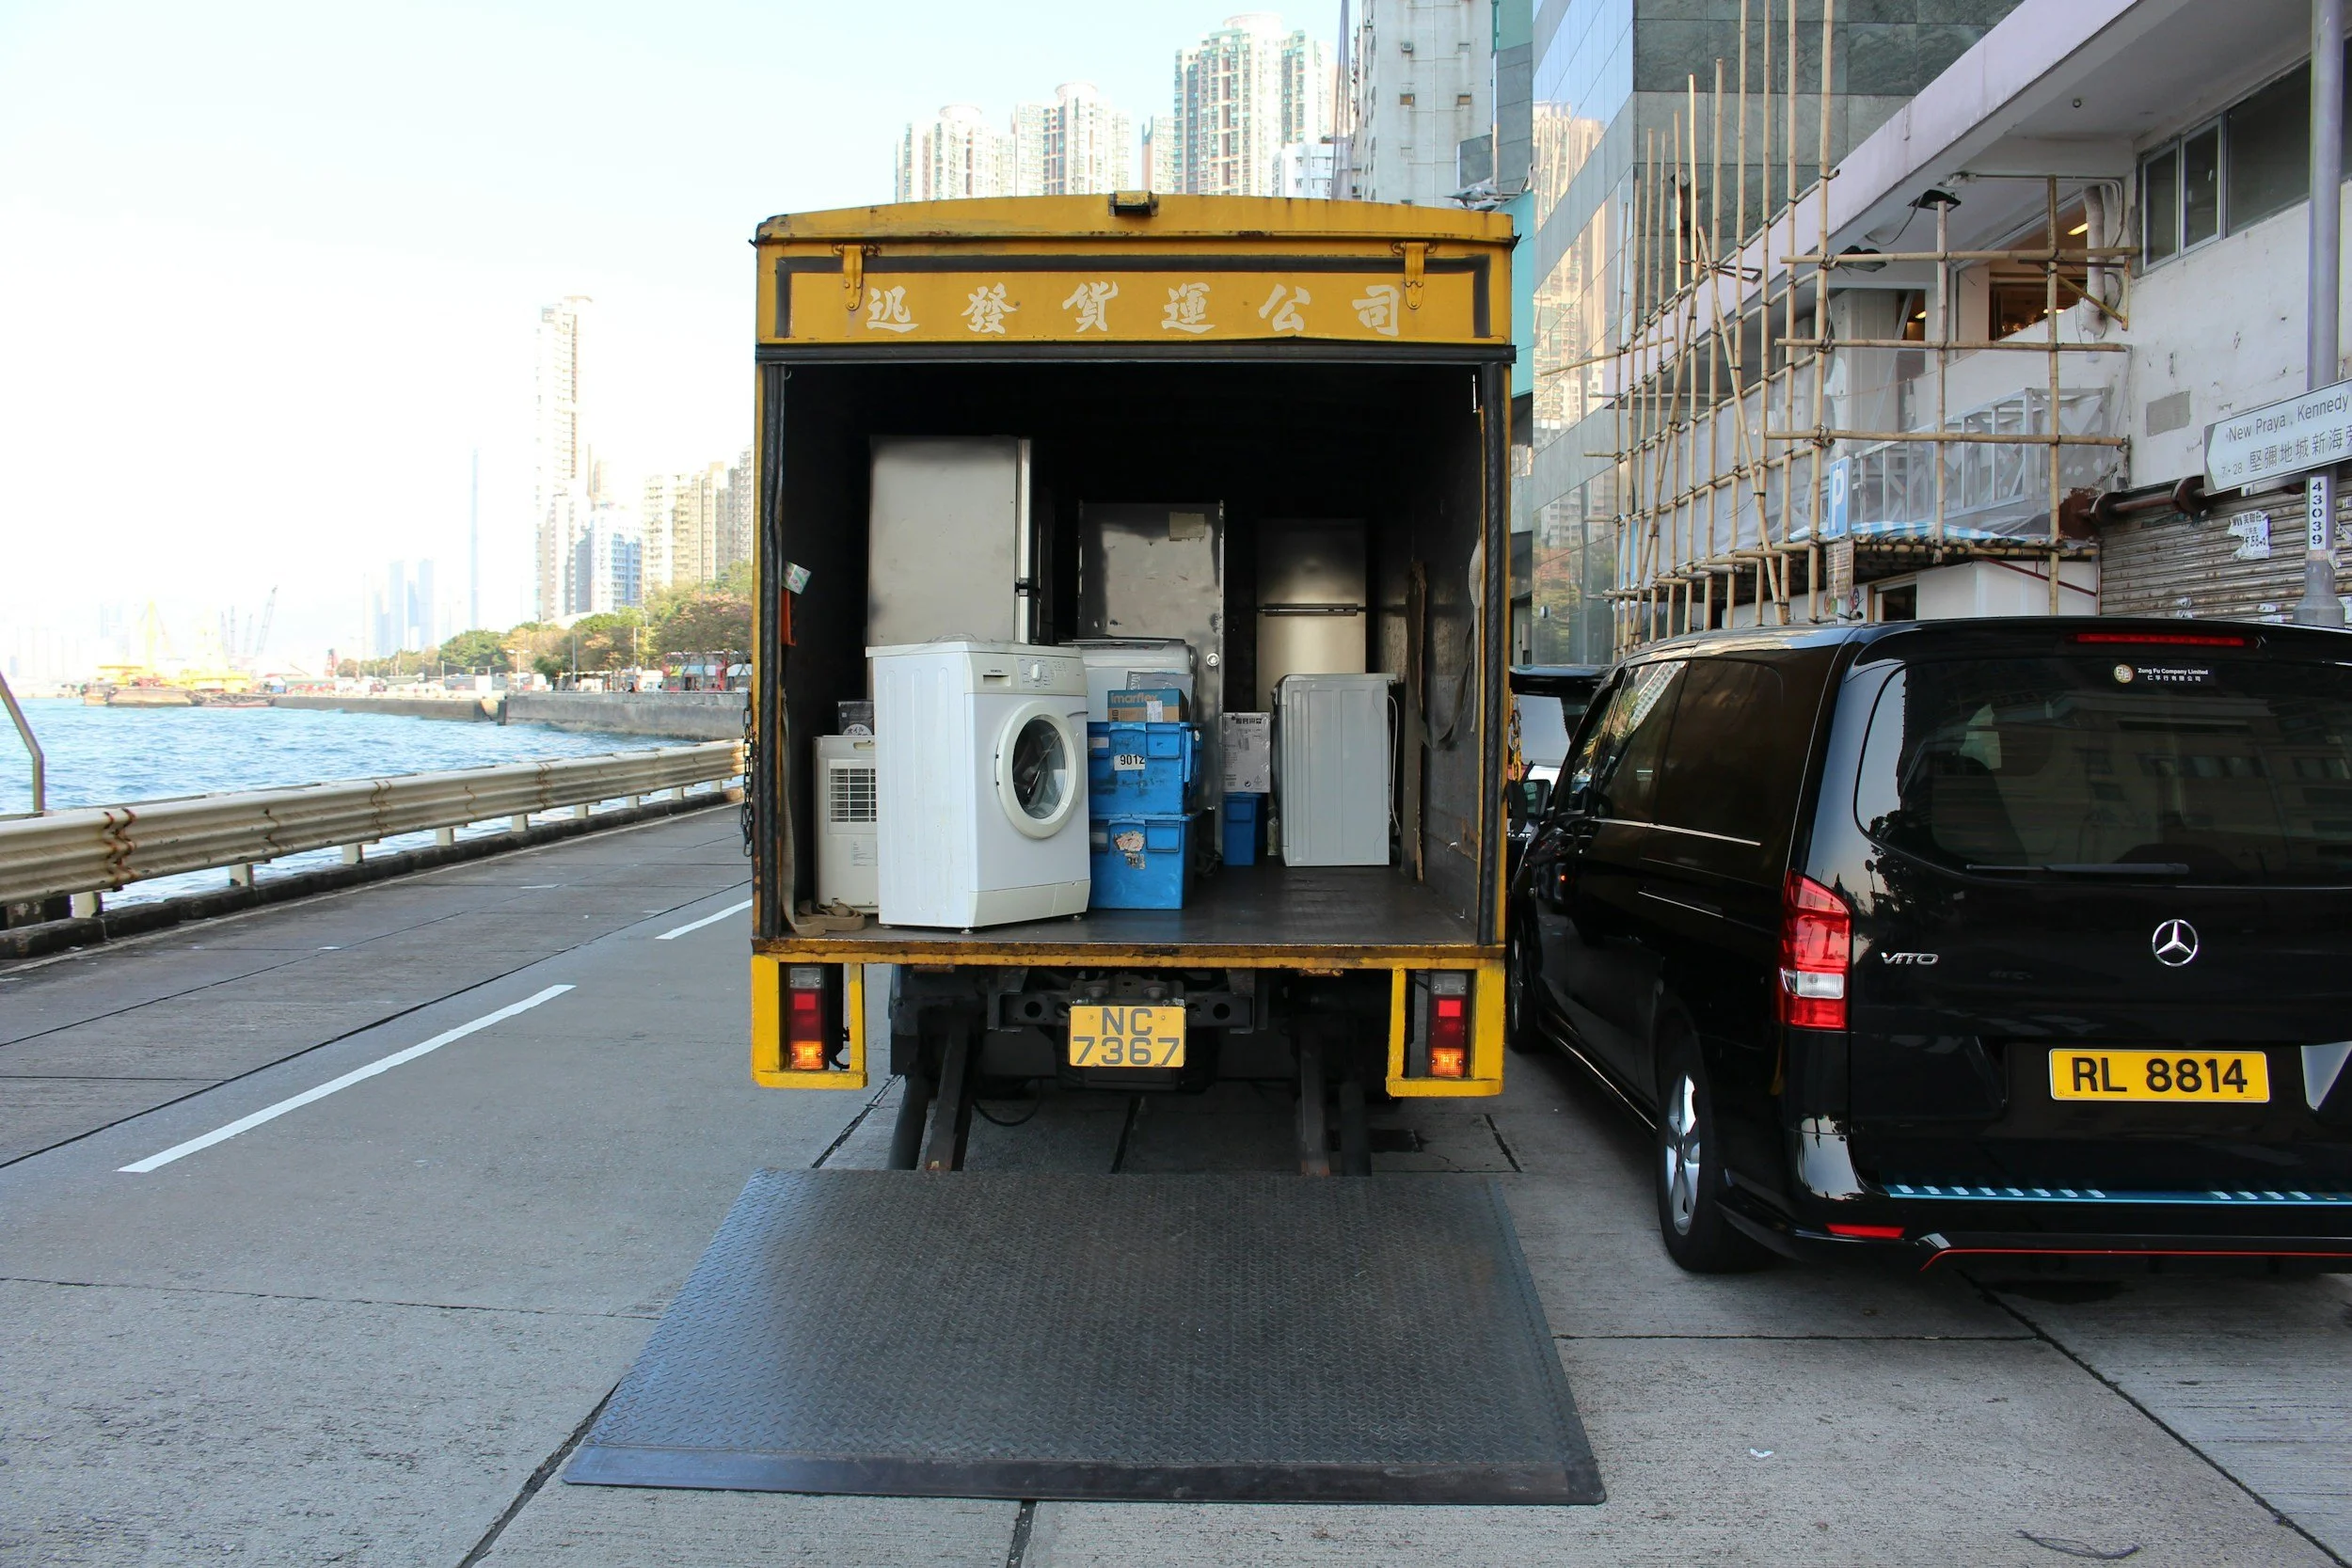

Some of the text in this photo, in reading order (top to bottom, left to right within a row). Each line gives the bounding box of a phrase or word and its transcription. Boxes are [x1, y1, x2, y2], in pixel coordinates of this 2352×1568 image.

[2229, 425, 2252, 443] New
[2297, 393, 2349, 422] Kennedy
[1831, 467, 1845, 531] P
[2312, 482, 2323, 546] 43039
[2137, 667, 2153, 675] Zung
[2161, 668, 2187, 676] Company
[1120, 754, 1145, 765] 9012
[1881, 952, 1939, 965] VITO
[1102, 1007, 1153, 1036] NC
[1073, 1037, 1180, 1066] 7367
[2072, 1057, 2248, 1093] RL 8814
